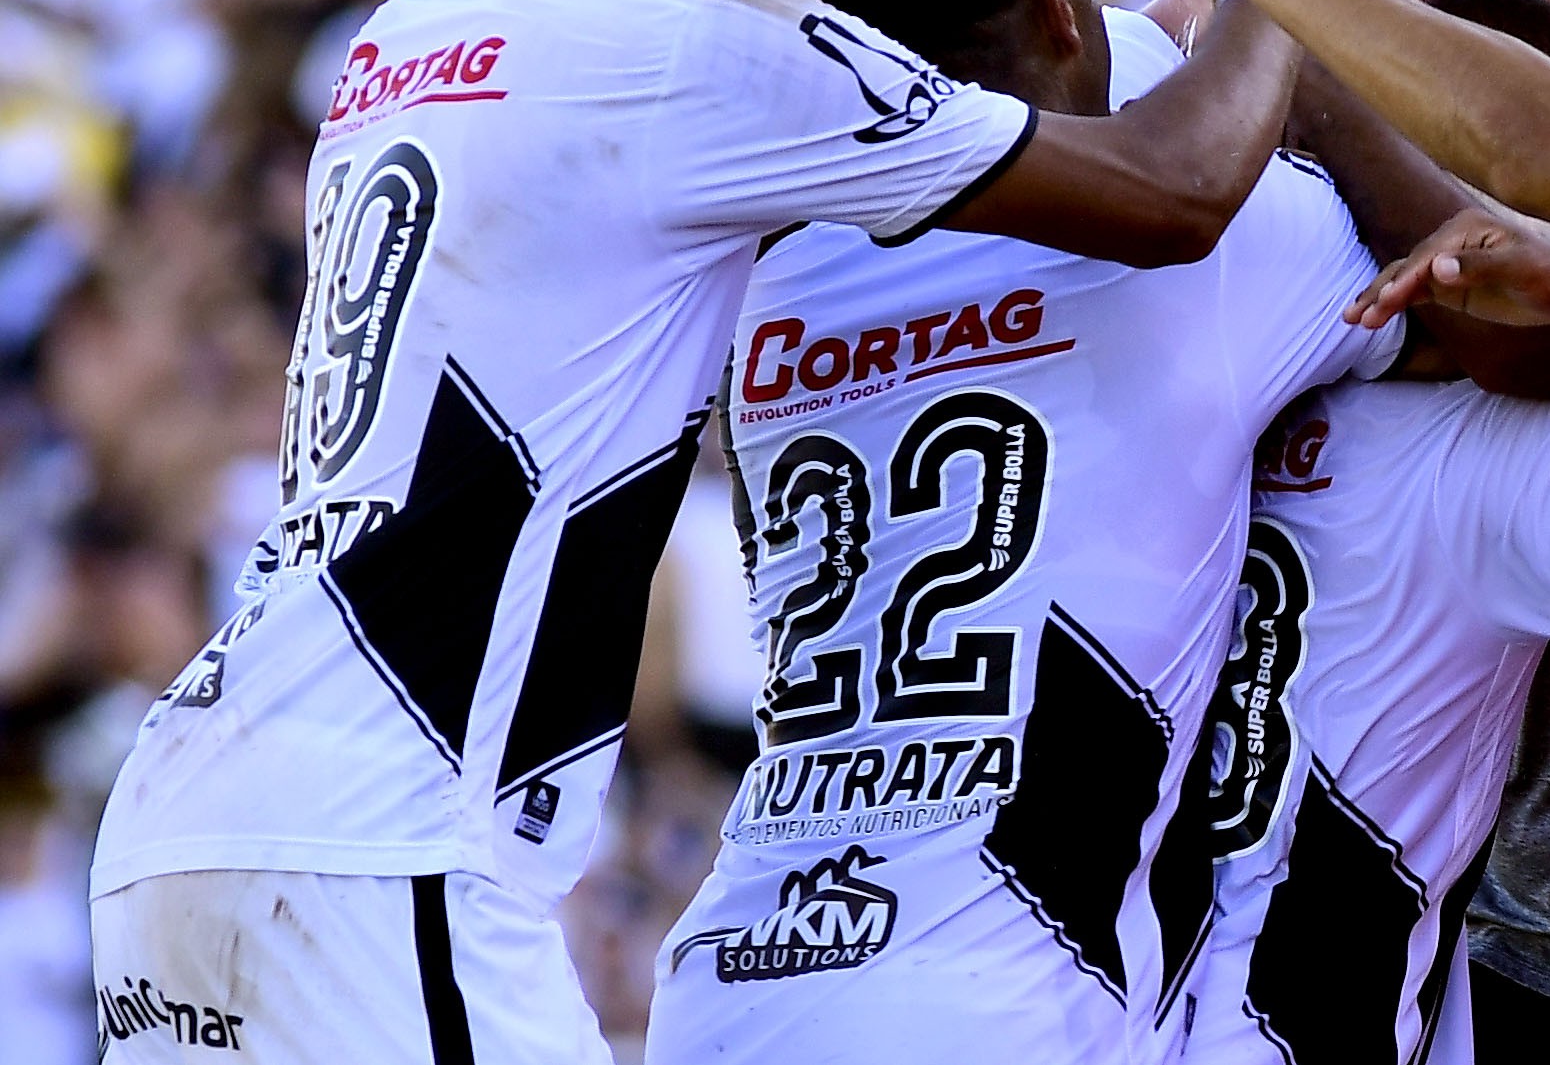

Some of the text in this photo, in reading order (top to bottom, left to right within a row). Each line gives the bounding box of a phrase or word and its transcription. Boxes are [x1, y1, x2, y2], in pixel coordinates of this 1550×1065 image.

[328, 36, 507, 122] CORTAG
[361, 225, 415, 359] SUPER BOLLA
[742, 288, 1045, 403] CORTAG
[740, 378, 897, 424] REVOLUTION TOOLS
[992, 423, 1026, 548] SUPER BOLLA
[756, 392, 1049, 747] 22
[1246, 618, 1277, 756] SUPER BOLLA
[745, 736, 1015, 821] NUTRATA
[723, 944, 880, 973] SOLUTIONS
